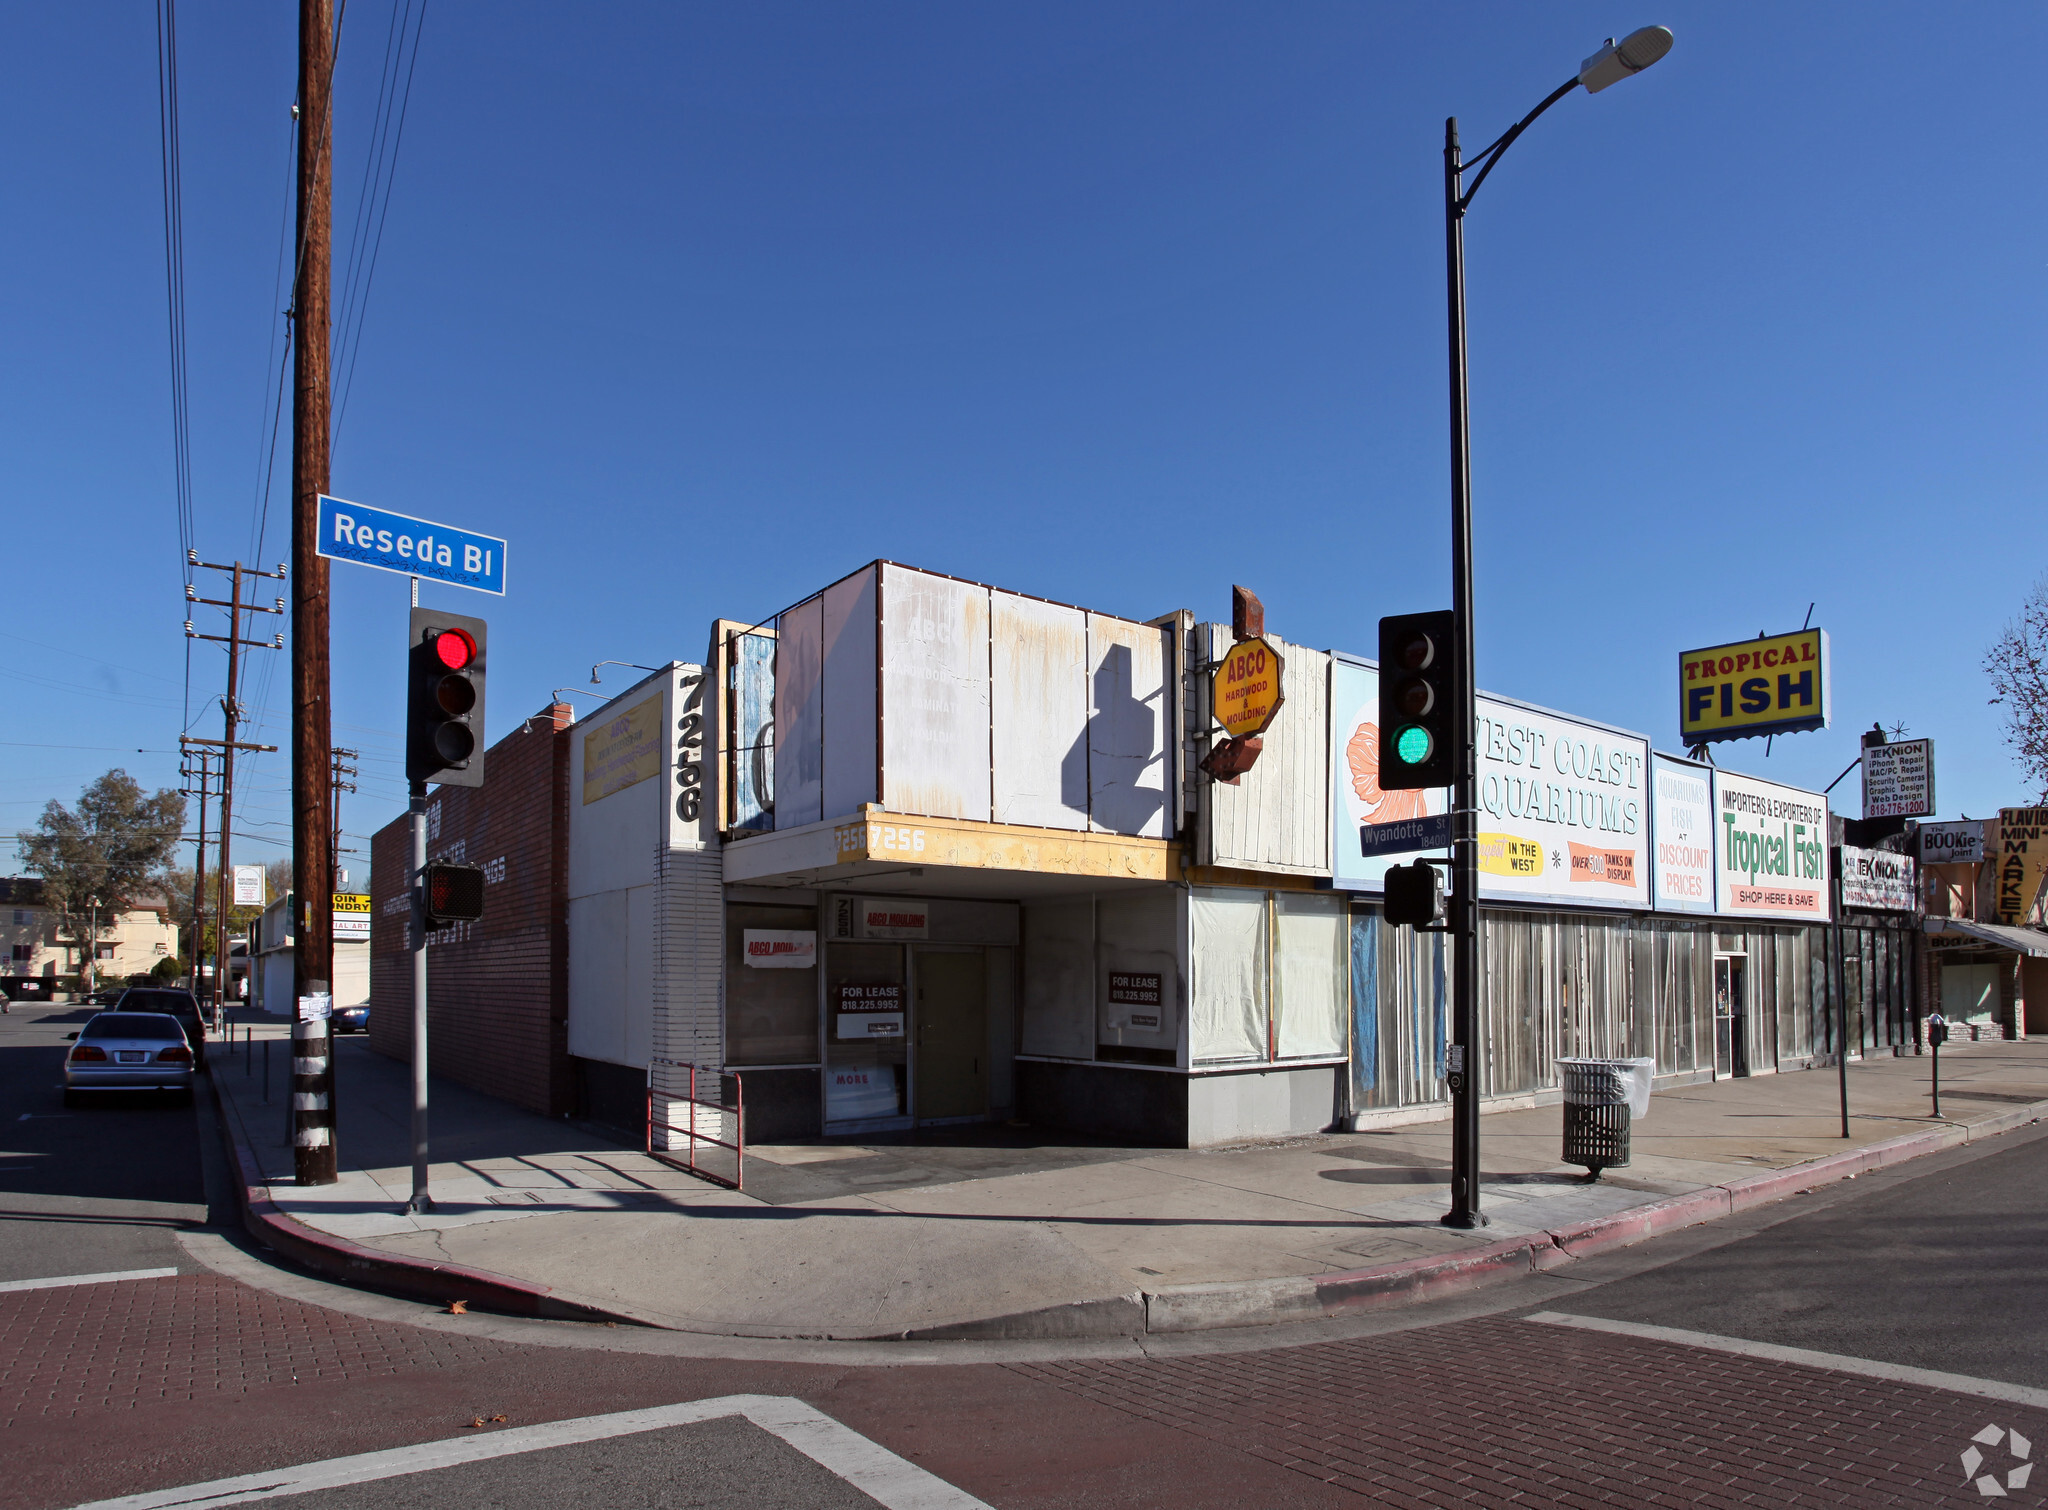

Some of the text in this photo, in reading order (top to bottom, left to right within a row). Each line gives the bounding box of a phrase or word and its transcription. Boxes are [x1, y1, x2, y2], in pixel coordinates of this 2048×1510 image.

[334, 513, 452, 567] Reseda
[1227, 648, 1266, 684] ABCO
[1684, 642, 1815, 680] TROPICAL
[1225, 680, 1268, 702] HARDWOOD
[1688, 670, 1812, 722] FISH
[1243, 698, 1249, 709] &
[1226, 705, 1267, 726] MOULDING
[677, 674, 708, 823] 7256
[1554, 734, 1641, 789] COAST
[1869, 755, 1924, 768] iPhone Repair
[1870, 764, 1924, 777] MAC/PC Repair
[1869, 774, 1925, 786] Security Cameras
[1658, 775, 1705, 805] AQUARIUMS
[1869, 783, 1924, 796] Graphic Design
[1872, 792, 1922, 804] Web Design
[1476, 771, 1640, 835] QUARIUMS
[1722, 789, 1822, 825] IMPORTERS & EXPORTERS OF
[1870, 800, 1924, 816] 818-776-1200
[1671, 806, 1693, 830] FISH
[835, 826, 866, 853] 7256
[870, 825, 925, 851] 7256
[1364, 818, 1446, 845] Wyandotte St
[1678, 833, 1688, 841] AT
[1421, 834, 1446, 848] 18400
[1508, 841, 1537, 857] IN THE
[1723, 812, 1823, 886] Tropical Fish
[1510, 858, 1535, 872] WEST
[1572, 854, 1605, 874] OVER 500
[1605, 854, 1633, 868] TANKS ON
[1659, 843, 1708, 870] DISCOUNT
[1607, 867, 1632, 881] DISPLAY
[2000, 841, 2028, 923] MARKET
[1666, 872, 1703, 897] PRICES
[335, 895, 357, 903] OIN
[1739, 891, 1814, 906] SHOP HERE & SAVE
[838, 899, 848, 936] 7256
[889, 913, 925, 926] MOULDING
[1112, 976, 1158, 988] FOR LEASE
[841, 986, 899, 998] FOR LEASE
[1112, 990, 1158, 1002] 818.225.9952
[841, 1000, 899, 1010] 818.225.9952
[836, 1074, 869, 1085] MORE
